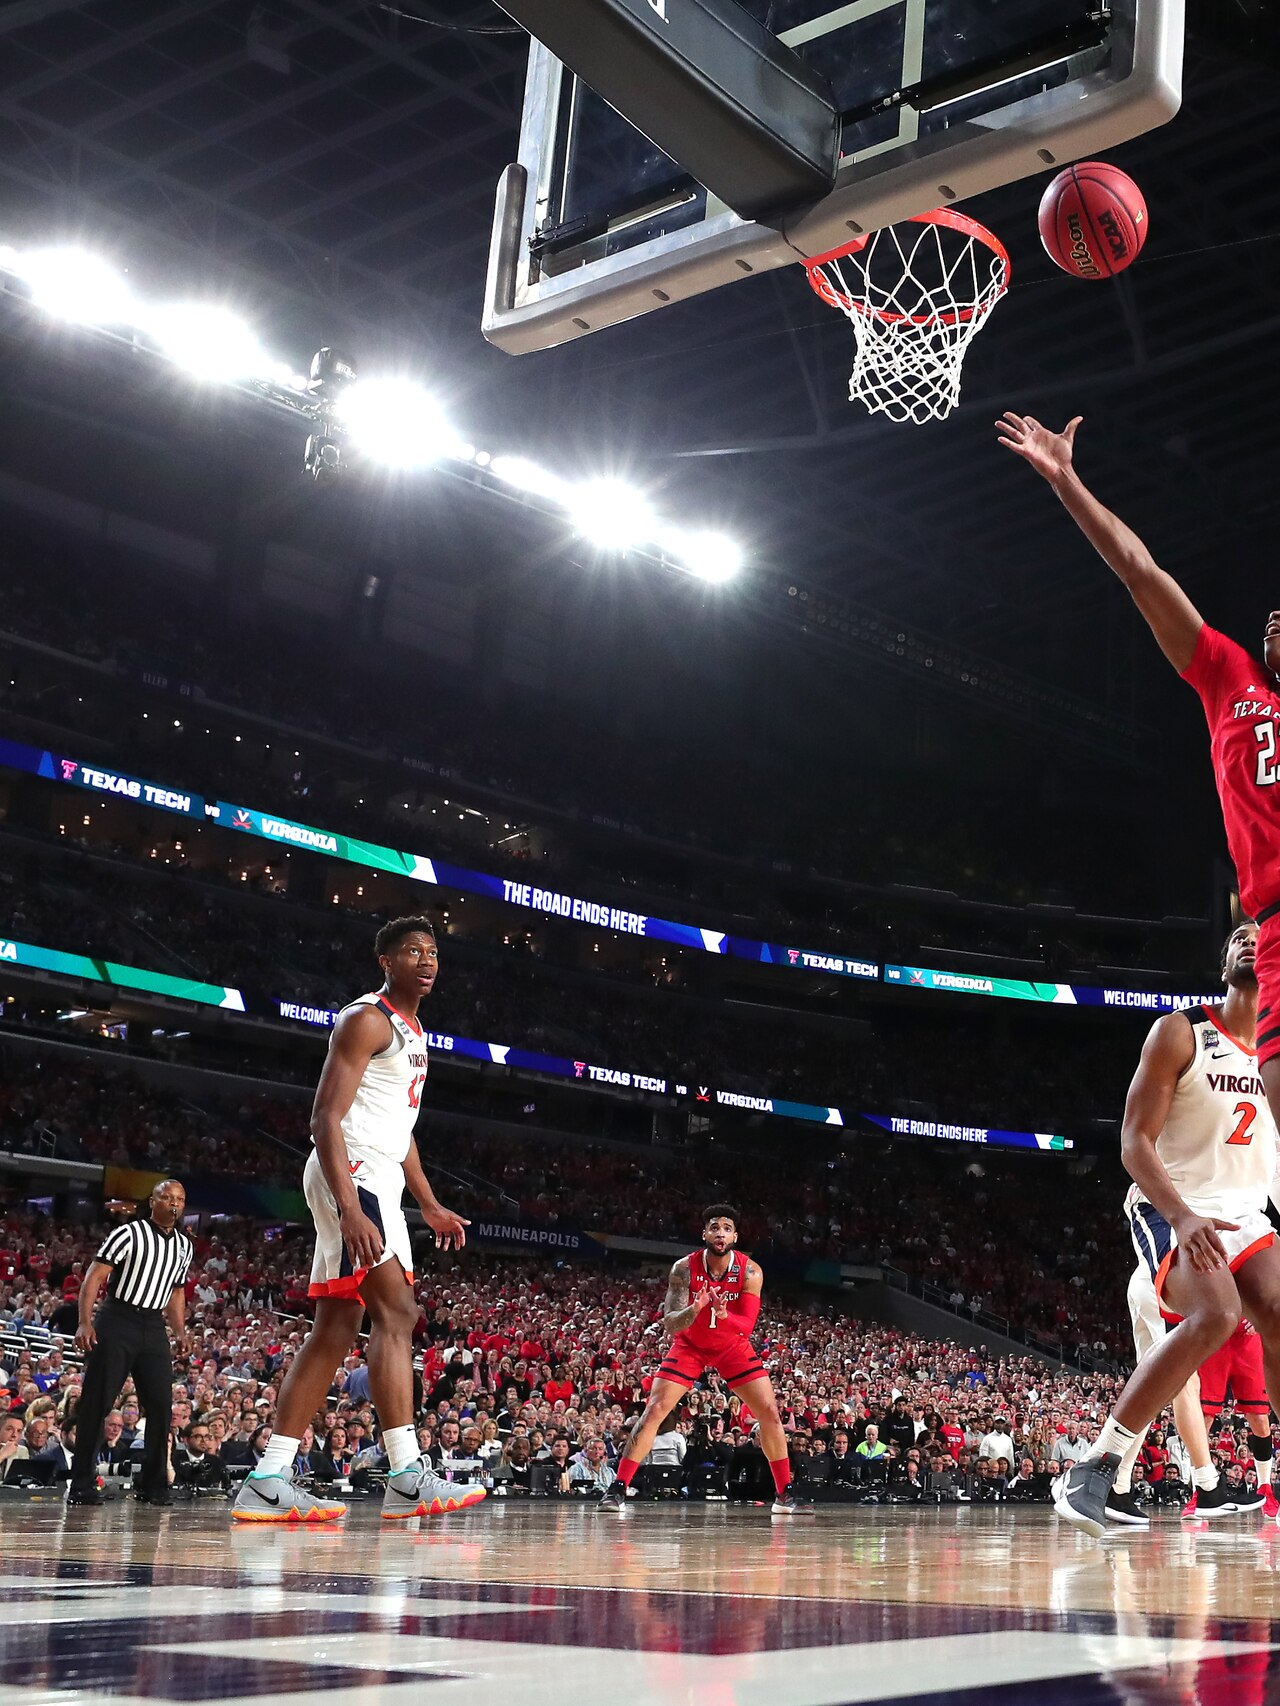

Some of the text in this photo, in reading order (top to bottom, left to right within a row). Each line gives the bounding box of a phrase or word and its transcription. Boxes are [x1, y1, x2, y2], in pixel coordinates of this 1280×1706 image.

[1098, 209, 1128, 261] NCAA
[82, 768, 141, 798] TEXAS
[144, 785, 191, 812] TECH
[262, 818, 338, 852] VIRGINIA
[503, 880, 648, 936] THE ROAD ENDS HERE
[802, 954, 844, 972] TEXAS
[846, 961, 879, 978] TECH
[932, 974, 994, 992] VIRGINIA
[280, 1002, 329, 1025] WELCOME
[1104, 990, 1159, 1008] WELCOME
[1161, 995, 1172, 1005] TO
[588, 1066, 631, 1086] TEXAS
[633, 1074, 666, 1093] TECH
[716, 1091, 774, 1112] VIRGINIA
[891, 1118, 989, 1143] THE ROAD ENDS HERE
[1225, 1102, 1257, 1145] 2
[480, 1224, 579, 1248] MINNEAPOLIS
[710, 1307, 716, 1329] 1
